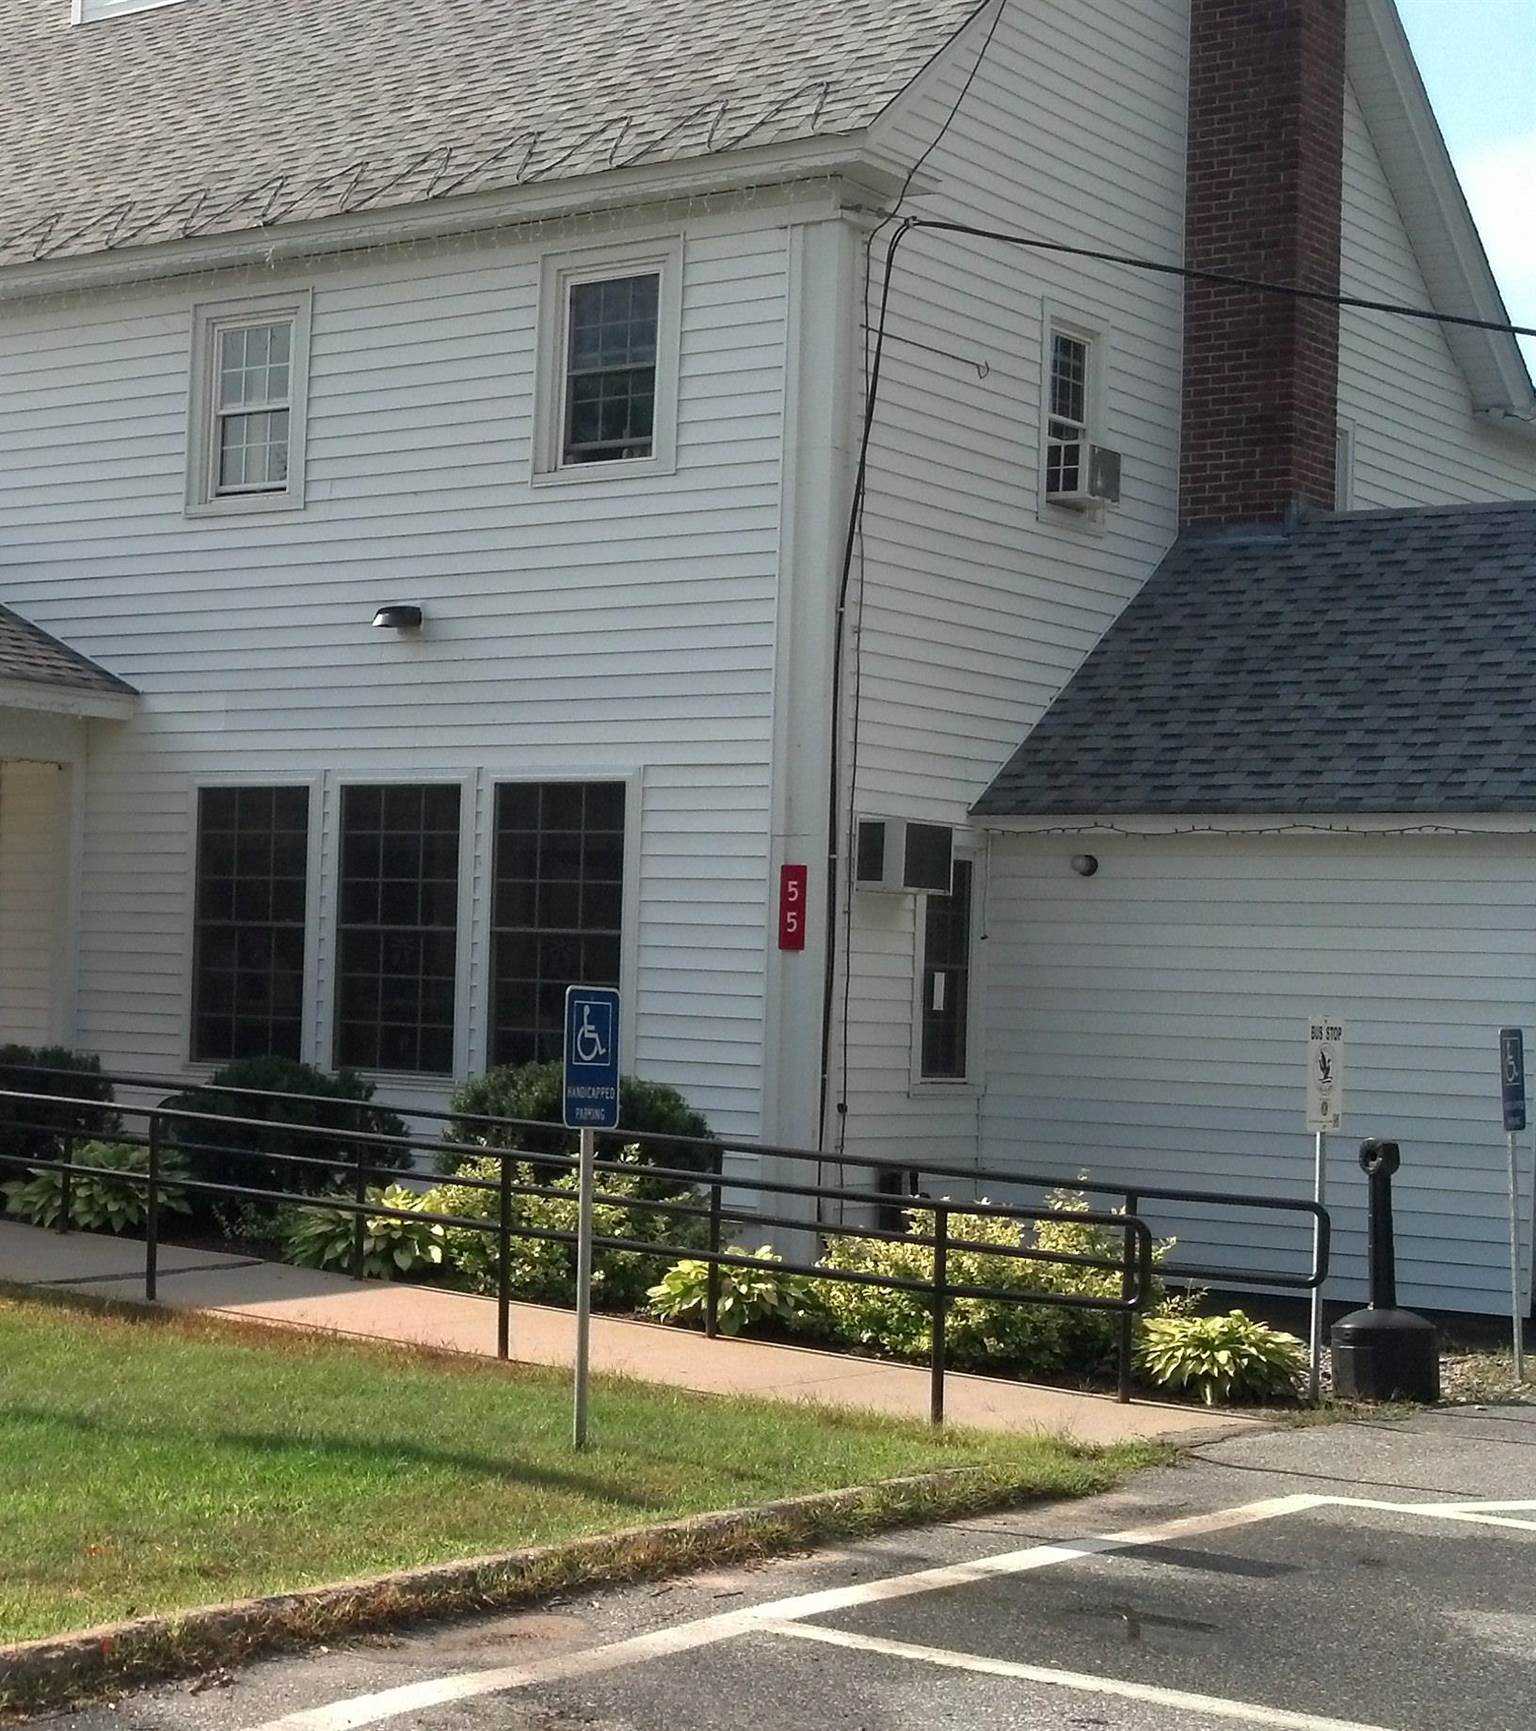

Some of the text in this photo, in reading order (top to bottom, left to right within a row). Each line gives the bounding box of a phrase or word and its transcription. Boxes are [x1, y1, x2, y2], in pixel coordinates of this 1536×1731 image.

[1311, 1025, 1342, 1040] BUS STOP
[567, 1086, 615, 1099] HANDICAPPED
[575, 1107, 605, 1120] PARKING
